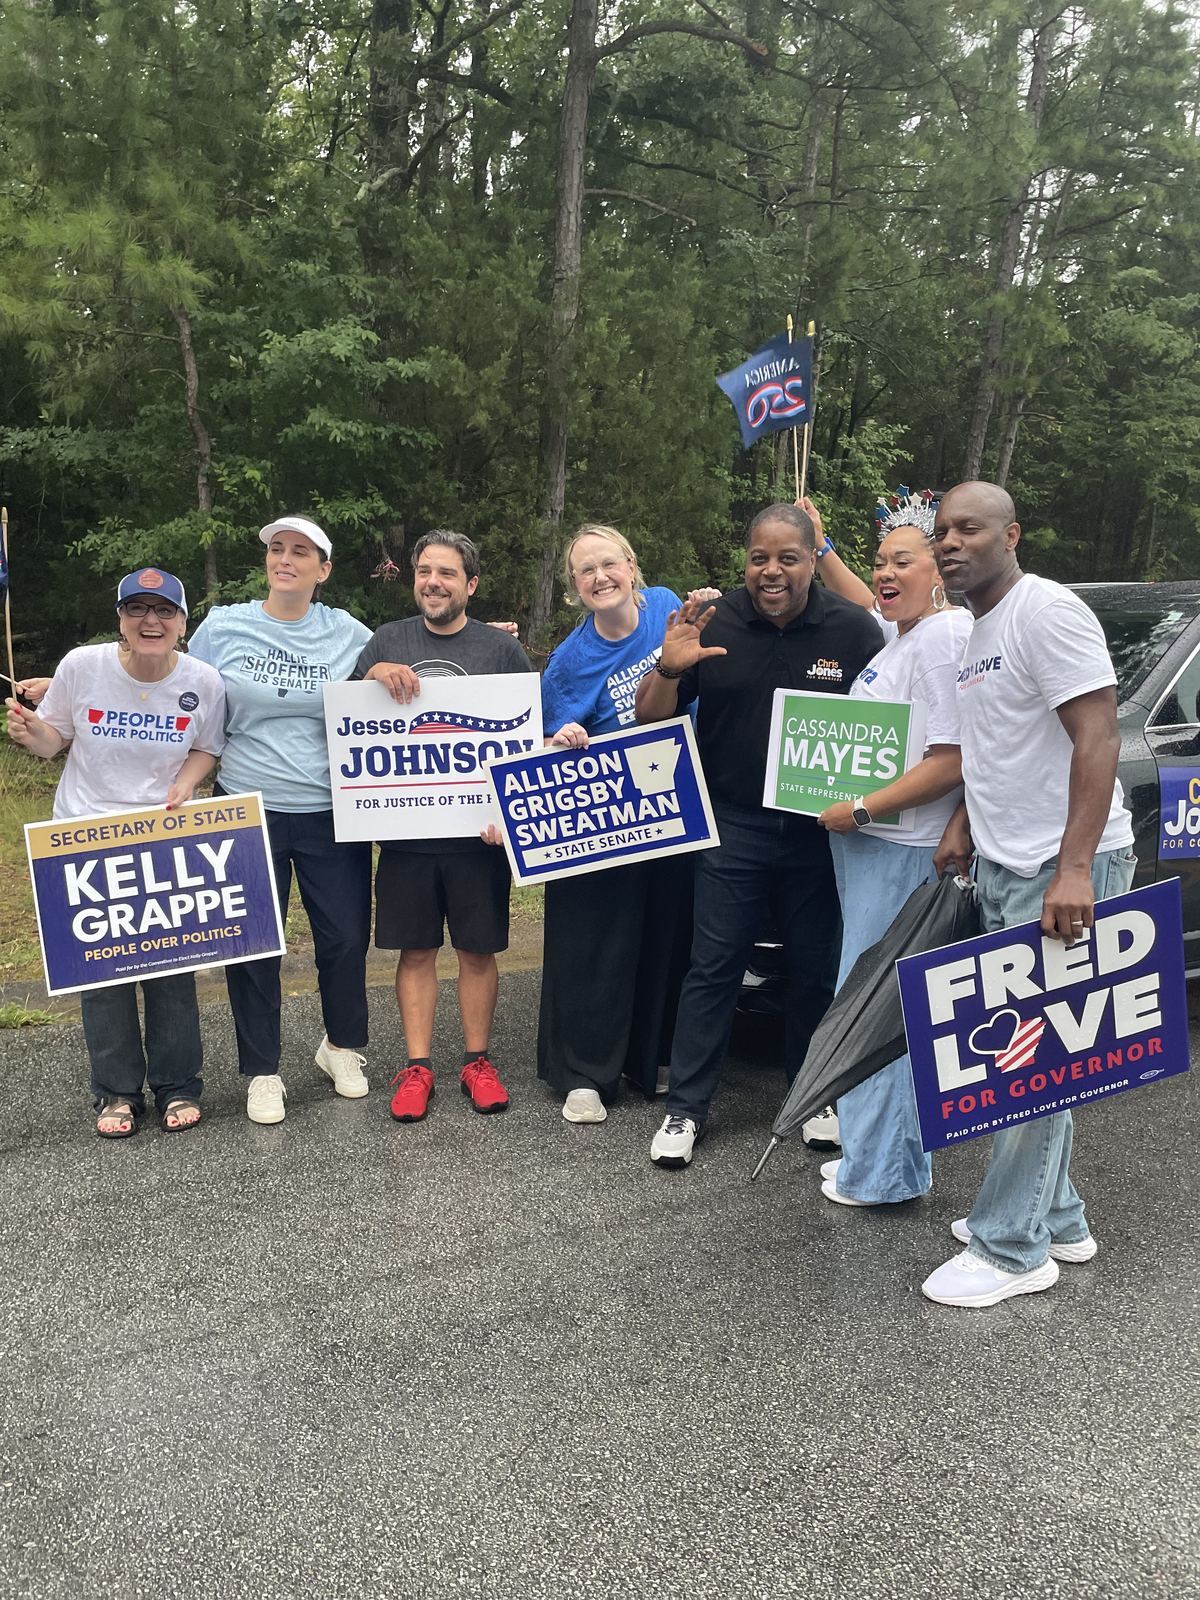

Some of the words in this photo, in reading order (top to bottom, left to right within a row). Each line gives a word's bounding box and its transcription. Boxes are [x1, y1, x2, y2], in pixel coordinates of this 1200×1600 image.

[244, 655, 329, 680] SHOFFNER
[267, 648, 308, 664] HALLIE
[607, 653, 657, 689] ALLISON
[806, 664, 843, 678] Jones
[817, 658, 839, 668] Chris
[253, 672, 269, 684] US
[272, 676, 317, 690] SENATE
[92, 726, 127, 739] OVER
[130, 729, 184, 743] POLITICS
[106, 710, 175, 731] PEOPLE
[336, 716, 407, 737] Jesse
[786, 716, 900, 746] CASSANDRA
[783, 736, 900, 780] MAYES
[504, 750, 624, 797] ALLISON
[780, 782, 805, 794] STATE
[355, 799, 381, 809] FOR
[383, 796, 435, 808] JUSTICE
[438, 796, 455, 806] OF
[458, 794, 482, 805] THE
[508, 776, 626, 821] GRIGSBY
[50, 819, 156, 848] SECRETARY
[162, 815, 187, 831] OF
[194, 806, 247, 827] STATE
[515, 791, 681, 847] SWEATMAN
[555, 841, 596, 858] STATE
[599, 828, 653, 849] SENATE
[1162, 839, 1183, 849] FOR
[63, 838, 235, 907] KELLY
[71, 884, 247, 943] GRAPPE
[84, 942, 137, 962] PEOPLE
[140, 934, 179, 953] OVER
[182, 925, 242, 944] POLITICS
[924, 910, 1157, 1026] FRED
[941, 1089, 997, 1120] FOR
[1009, 1037, 1164, 1098] GOVERNOR
[946, 1128, 969, 1140] PAID
[971, 1121, 990, 1133] FOR
[992, 1117, 1004, 1128] BY
[1006, 1109, 1031, 1122] FRED
[1033, 1101, 1057, 1114] LOVE
[1059, 1095, 1078, 1106] FOR
[1079, 1079, 1130, 1099] GOVERNOR
